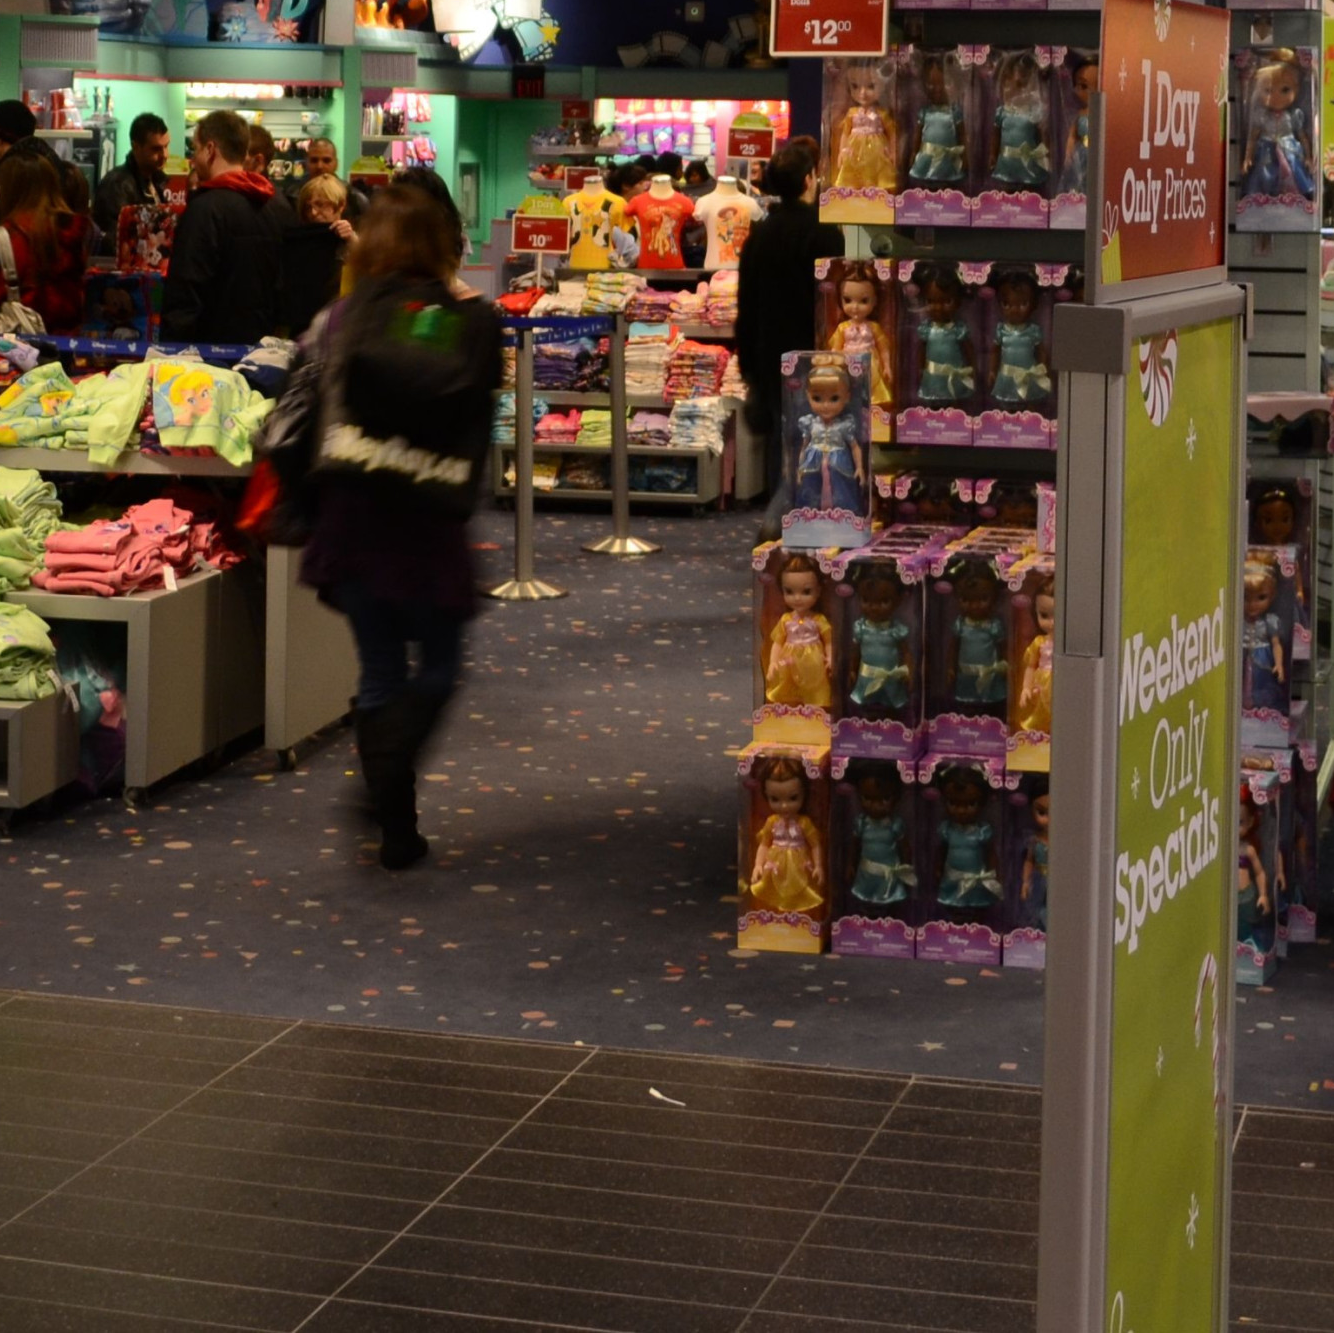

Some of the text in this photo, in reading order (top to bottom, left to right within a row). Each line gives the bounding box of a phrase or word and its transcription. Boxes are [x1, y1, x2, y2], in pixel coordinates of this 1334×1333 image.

[1139, 58, 1201, 165] 1 Day
[1121, 167, 1207, 234] Only Prices
[1119, 587, 1225, 727] Weekend
[1150, 699, 1208, 810] Only
[1114, 788, 1219, 955] Specials
